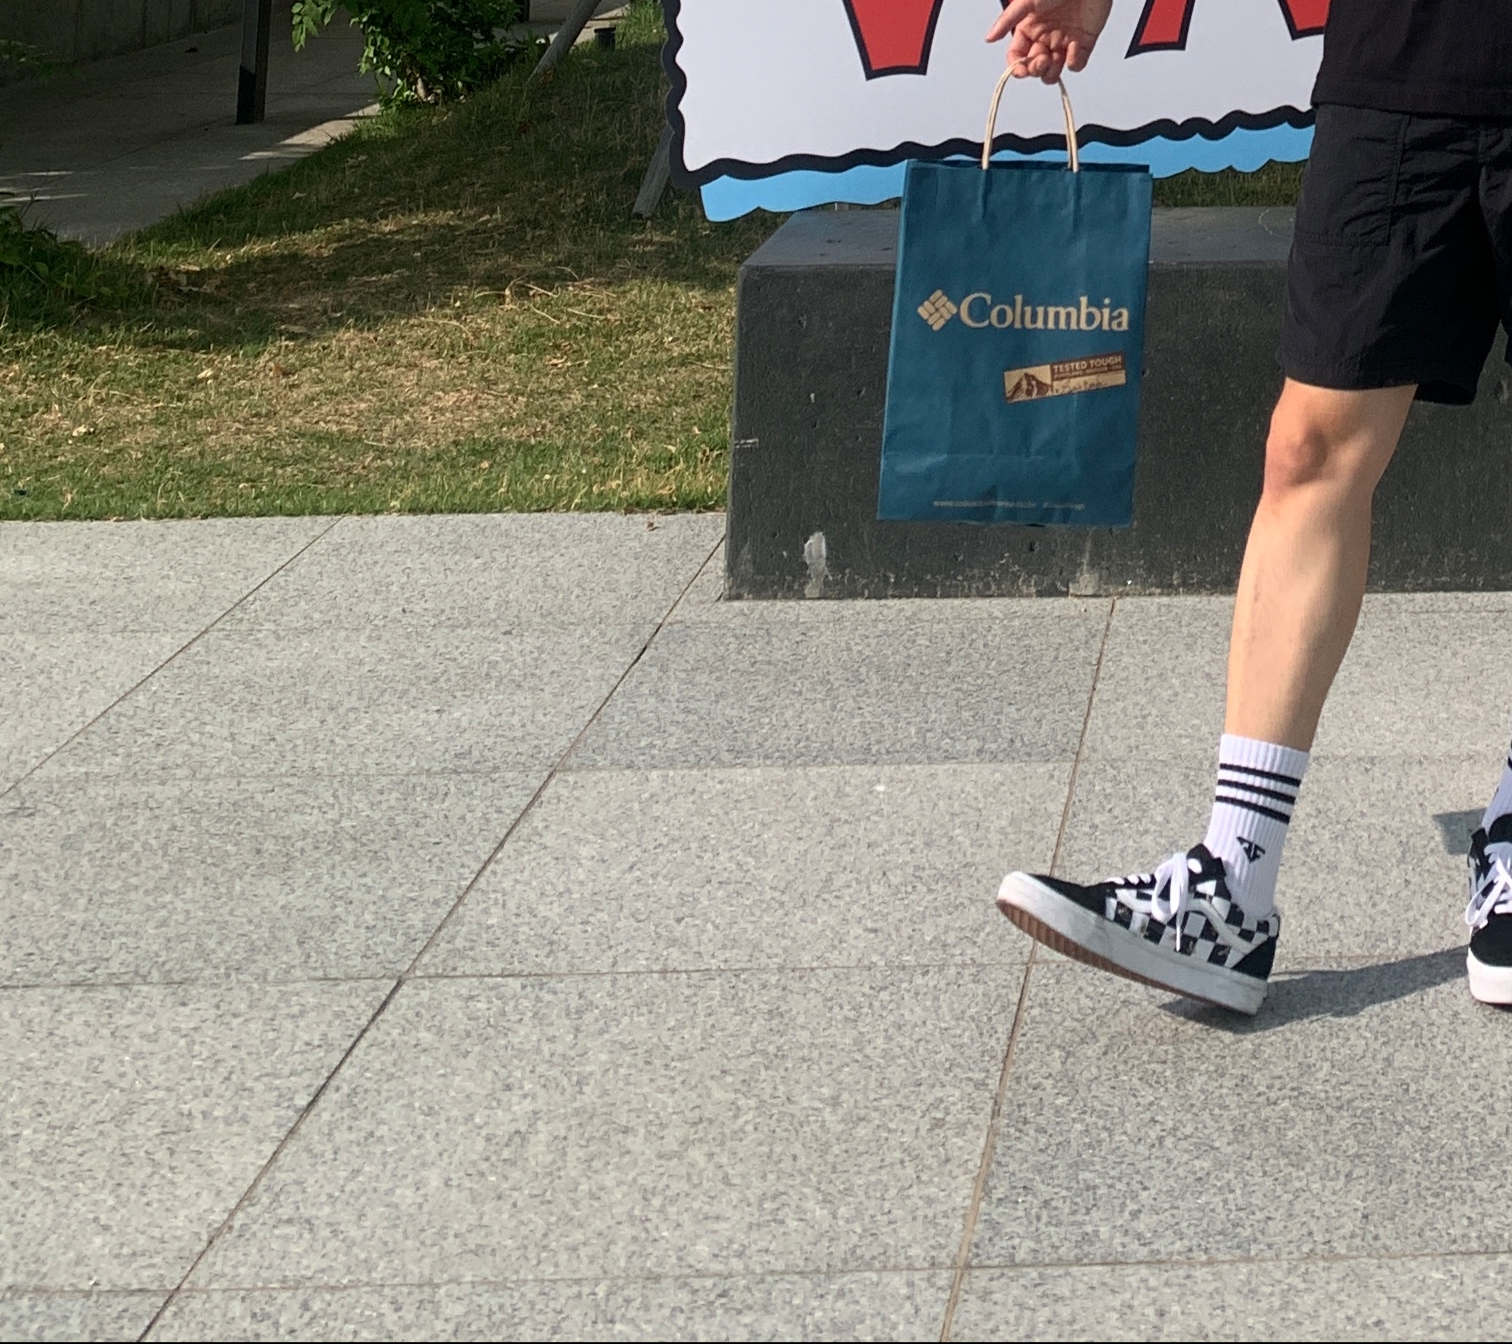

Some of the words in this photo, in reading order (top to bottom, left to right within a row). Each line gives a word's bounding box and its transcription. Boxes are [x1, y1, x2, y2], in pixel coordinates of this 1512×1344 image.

[959, 291, 1129, 333] Columbia
[1052, 360, 1088, 373] TESTED
[1089, 355, 1122, 368] TOUGH
